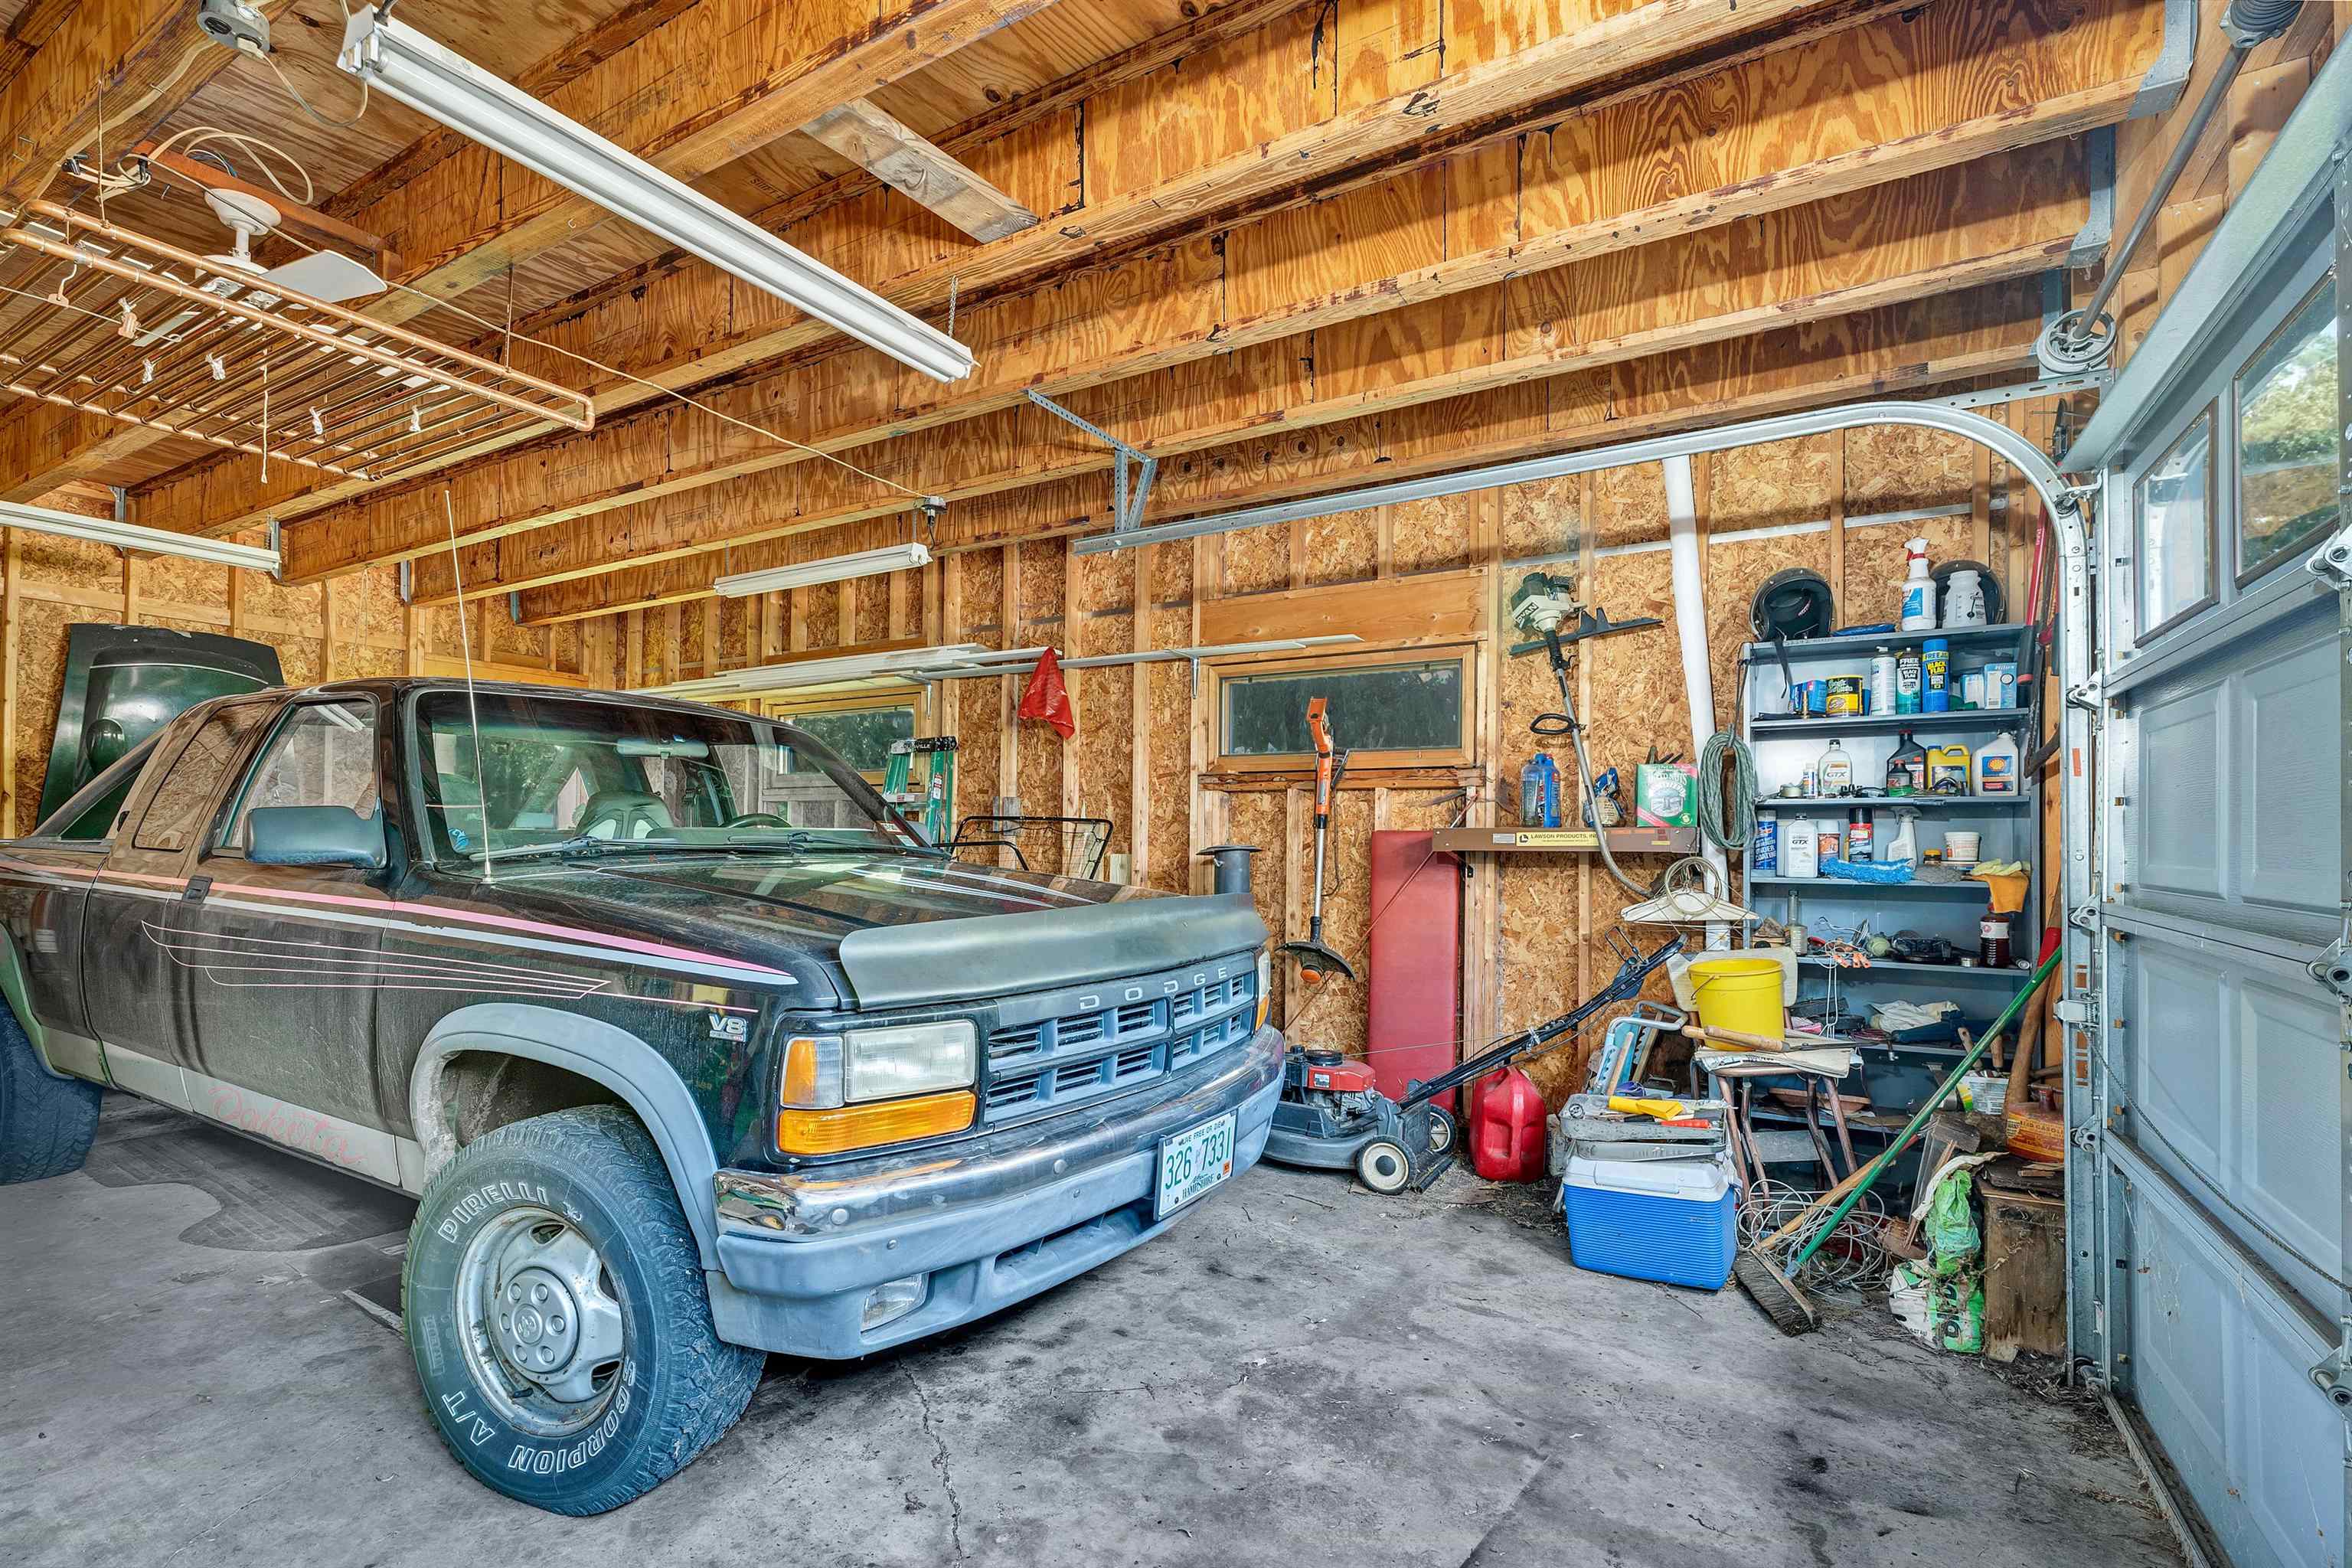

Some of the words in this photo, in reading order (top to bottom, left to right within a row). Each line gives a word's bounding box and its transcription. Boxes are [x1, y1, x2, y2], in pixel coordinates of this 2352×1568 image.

[1927, 662, 1946, 671] BLACK
[1079, 967, 1229, 1010] DODGE
[708, 1013, 747, 1034] V8
[207, 1086, 368, 1165] Dakota
[1194, 1129, 1205, 1138] FREE
[1165, 1146, 1192, 1190] 326
[1201, 1127, 1231, 1171] 7331
[1182, 1173, 1214, 1200] HAMPSHIRE
[438, 1181, 548, 1244] PIRELLI
[442, 1390, 496, 1447] A/T
[508, 1358, 637, 1475] SCORPION
